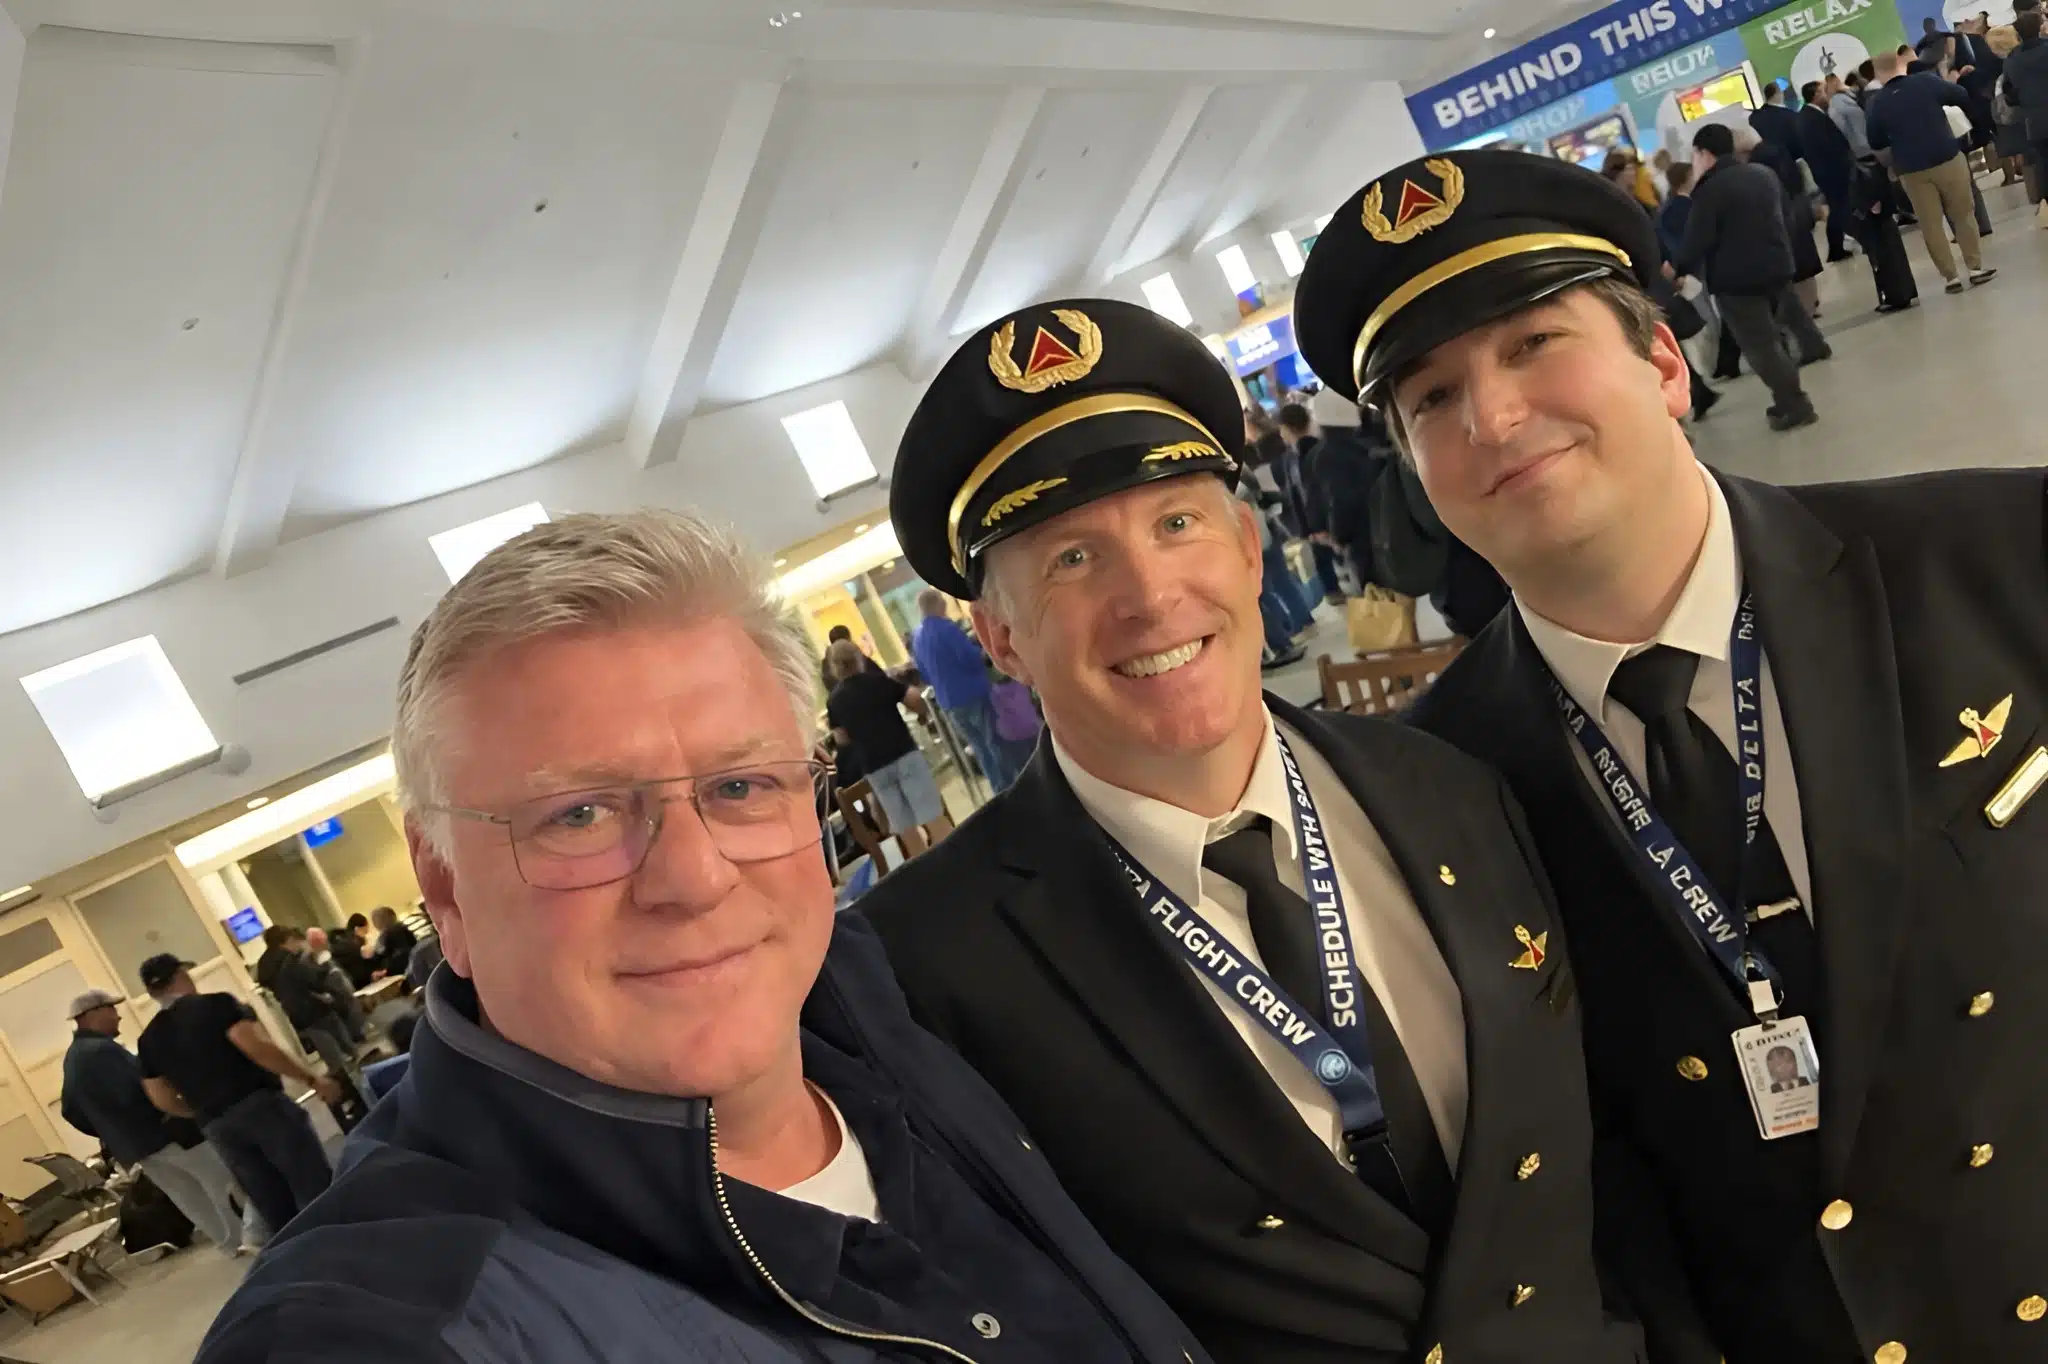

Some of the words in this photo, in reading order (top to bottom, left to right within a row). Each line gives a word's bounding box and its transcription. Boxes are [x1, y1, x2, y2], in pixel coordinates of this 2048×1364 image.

[1432, 43, 1583, 129] BEHIND
[1590, 0, 1677, 57] THIS
[1763, 0, 1873, 45] RELAX
[1736, 677, 1762, 781] DELTA
[1150, 896, 1242, 977] FLIGHT
[1235, 972, 1318, 1047] CREW
[1312, 878, 1357, 1028] SCHEDULE
